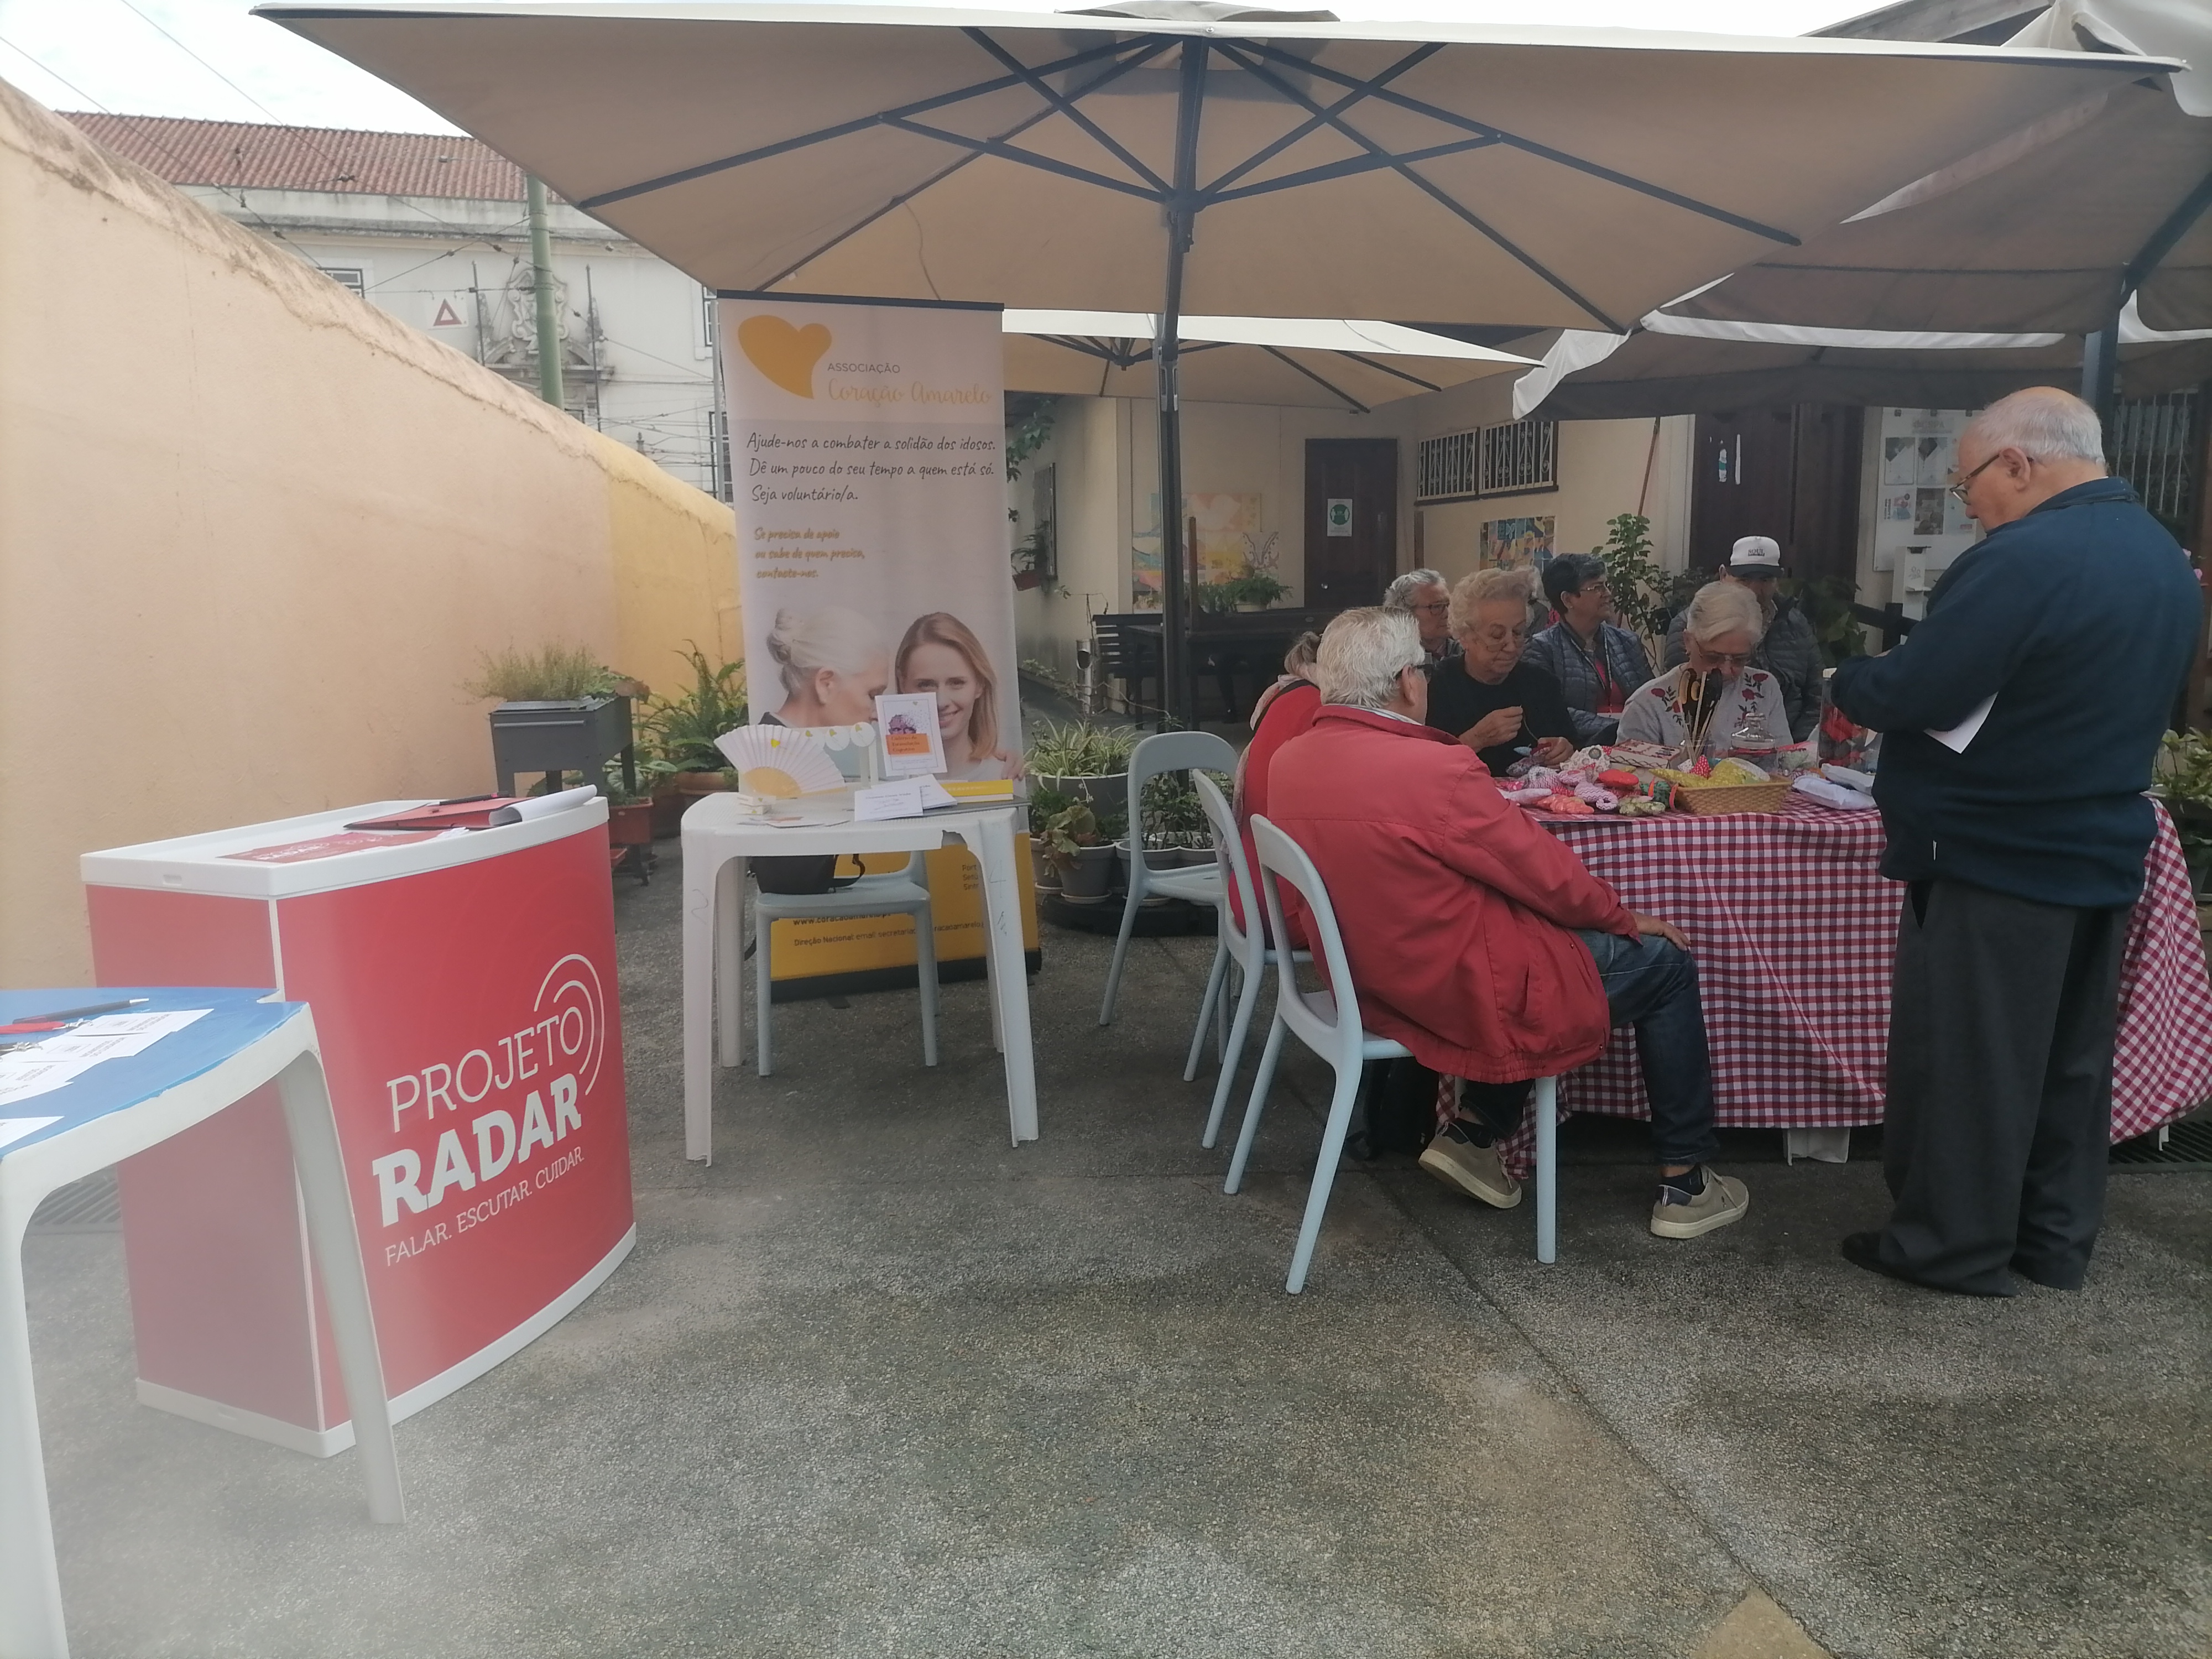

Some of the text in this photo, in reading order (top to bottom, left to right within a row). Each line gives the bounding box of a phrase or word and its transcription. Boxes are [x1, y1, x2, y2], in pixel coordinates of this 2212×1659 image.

[827, 363, 901, 374] ASSOCIAÇÃO
[828, 378, 992, 408] Coração Amarelo
[747, 432, 996, 452] Ajude-nos a combater a solidão dos idosos.
[749, 457, 995, 479] Dê um pouco do seu tempo a quem está só.
[752, 484, 859, 504] Seja voluntário/a.
[754, 527, 841, 542] Se precisa de apoio
[755, 551, 766, 559] ou
[768, 546, 790, 559] sabe
[792, 546, 803, 559] de
[805, 551, 829, 562] quem
[794, 937, 822, 947] Direção
[386, 1006, 584, 1133] PROJETO
[372, 1072, 582, 1228] RADAR
[385, 1146, 585, 1267] FALAR. ESCUTAR. CUIDAR.
